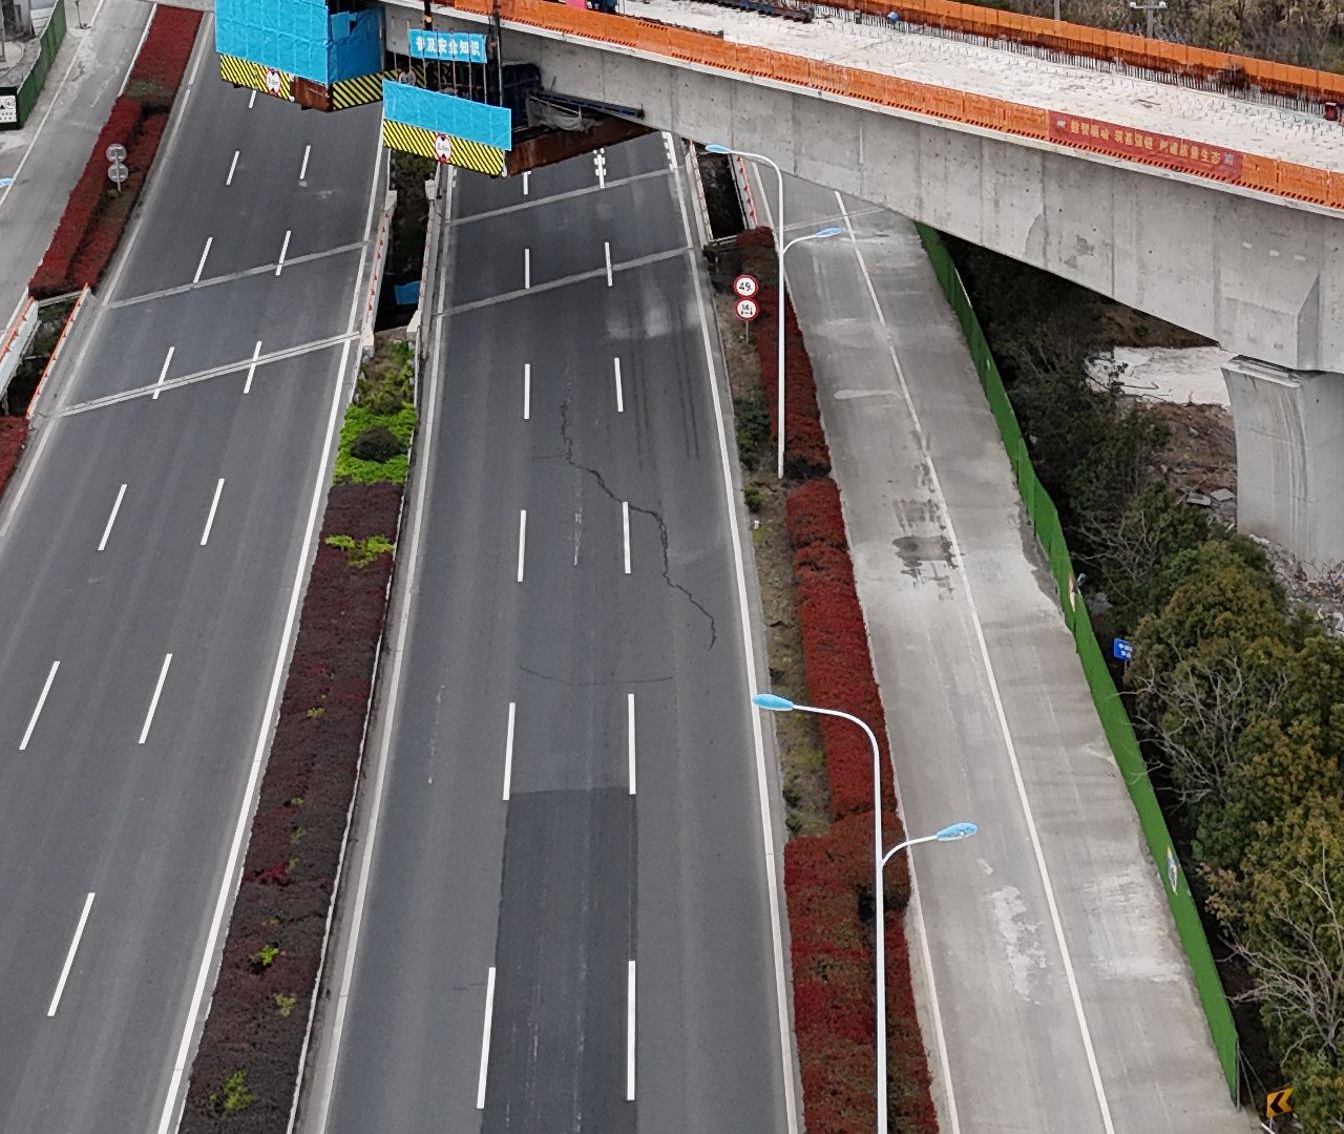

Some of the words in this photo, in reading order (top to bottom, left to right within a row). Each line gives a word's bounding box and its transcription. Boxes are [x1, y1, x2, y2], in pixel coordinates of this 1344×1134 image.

[415, 35, 481, 57] 普及安全知识
